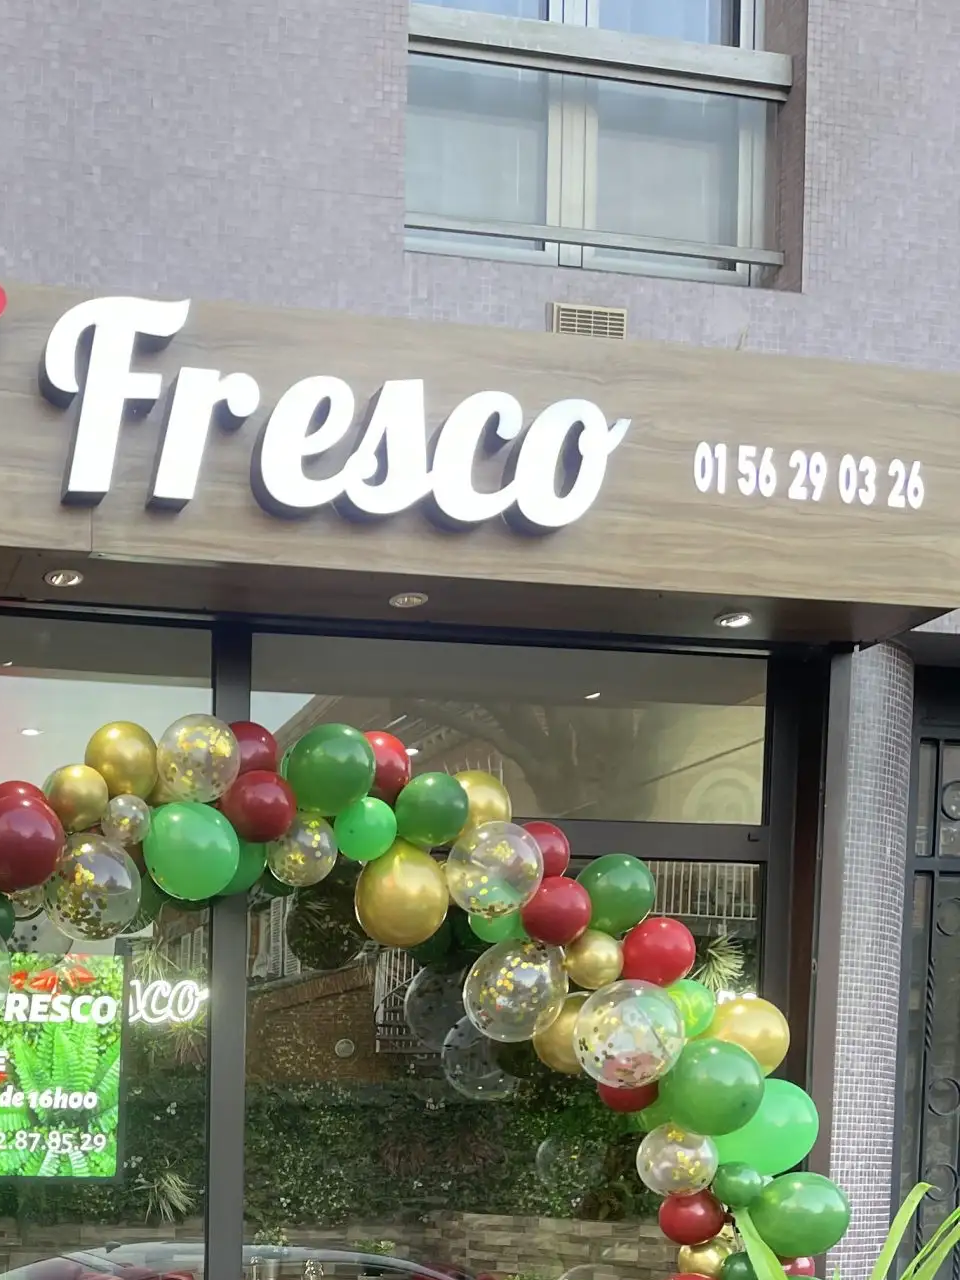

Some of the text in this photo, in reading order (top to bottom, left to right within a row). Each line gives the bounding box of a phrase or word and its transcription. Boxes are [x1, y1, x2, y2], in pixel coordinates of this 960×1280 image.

[44, 295, 632, 528] Fresco
[693, 441, 925, 510] 01 56 29 03 26
[26, 1086, 98, 1110] 16h00
